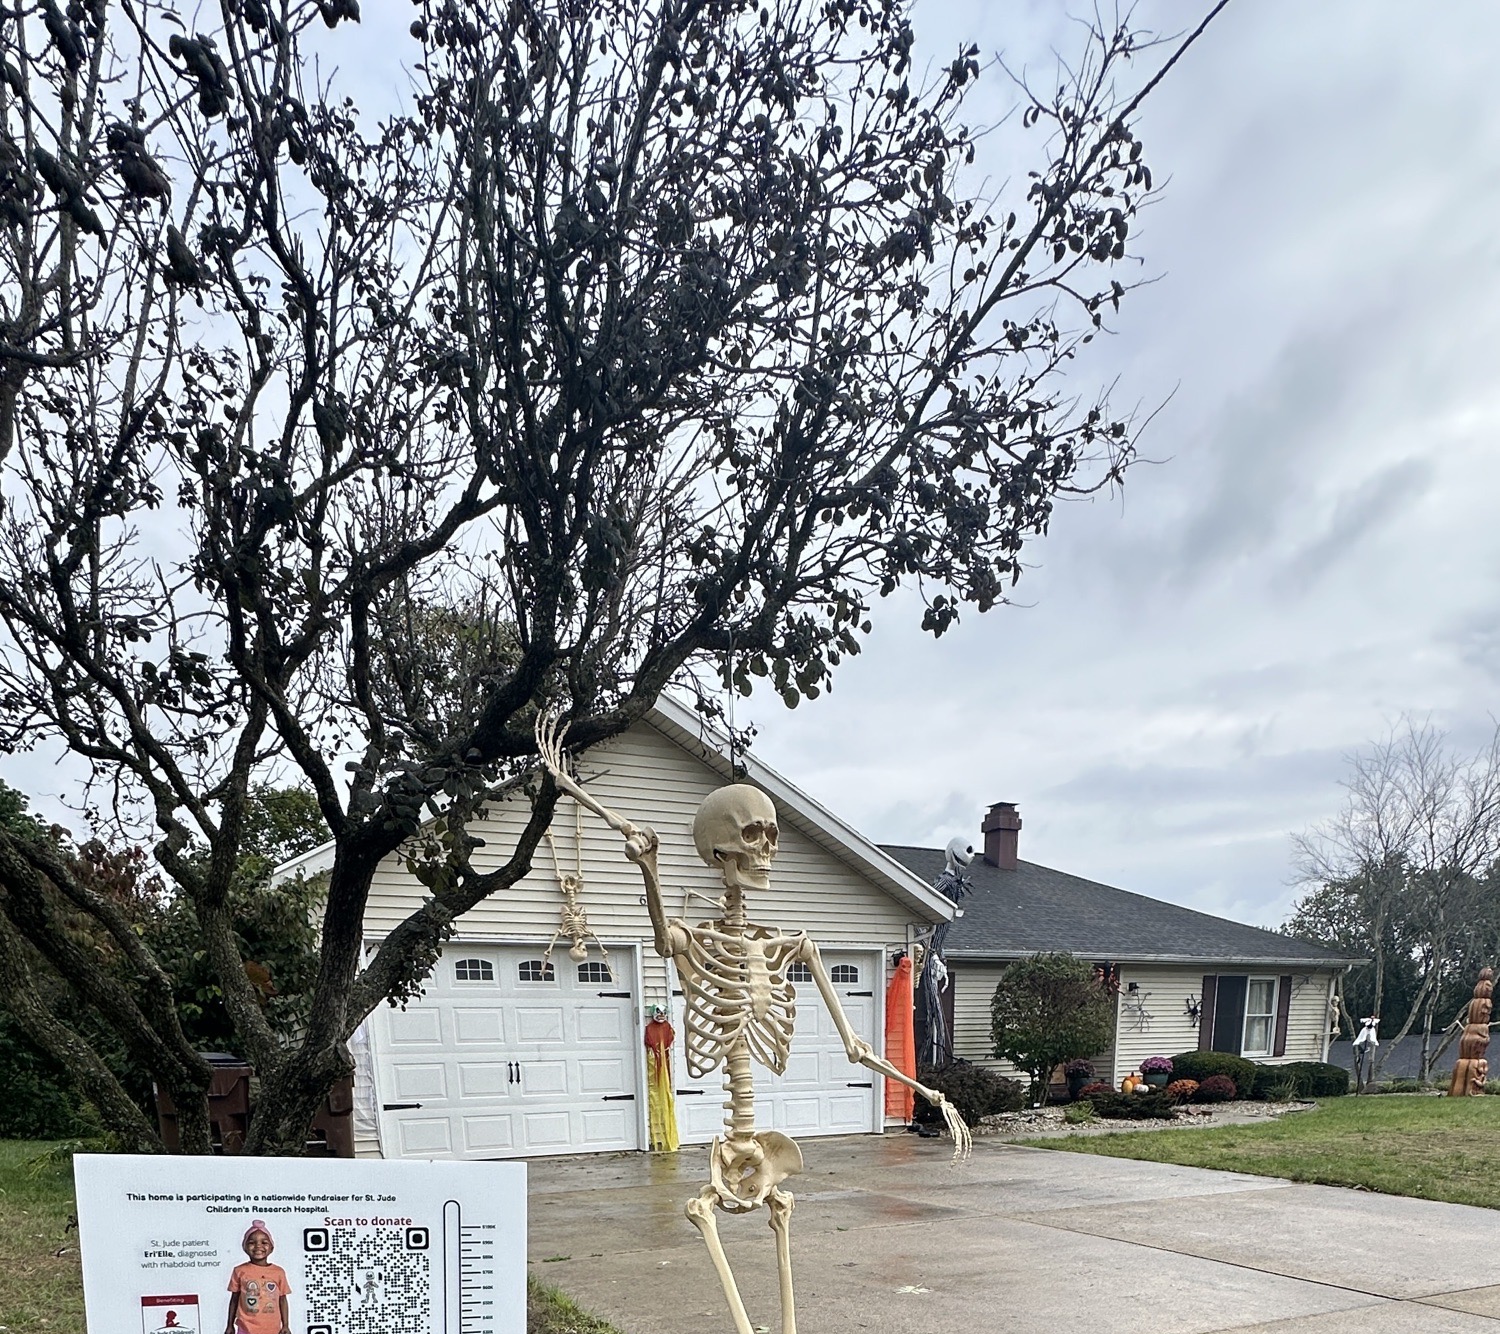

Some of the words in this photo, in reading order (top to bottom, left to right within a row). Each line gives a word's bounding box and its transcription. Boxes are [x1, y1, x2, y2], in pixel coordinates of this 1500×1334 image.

[126, 1193, 146, 1201] This
[148, 1193, 174, 1201] home
[176, 1193, 184, 1201] is
[186, 1193, 241, 1203] participating
[377, 1194, 396, 1202] Jude
[206, 1205, 250, 1213] Children's
[294, 1206, 329, 1214] Hospital.
[324, 1216, 352, 1226] Scan
[356, 1217, 368, 1226] to
[371, 1216, 412, 1226] donate
[162, 1240, 180, 1248] Jude
[182, 1240, 210, 1248] patient
[177, 1250, 217, 1258] diagnosed
